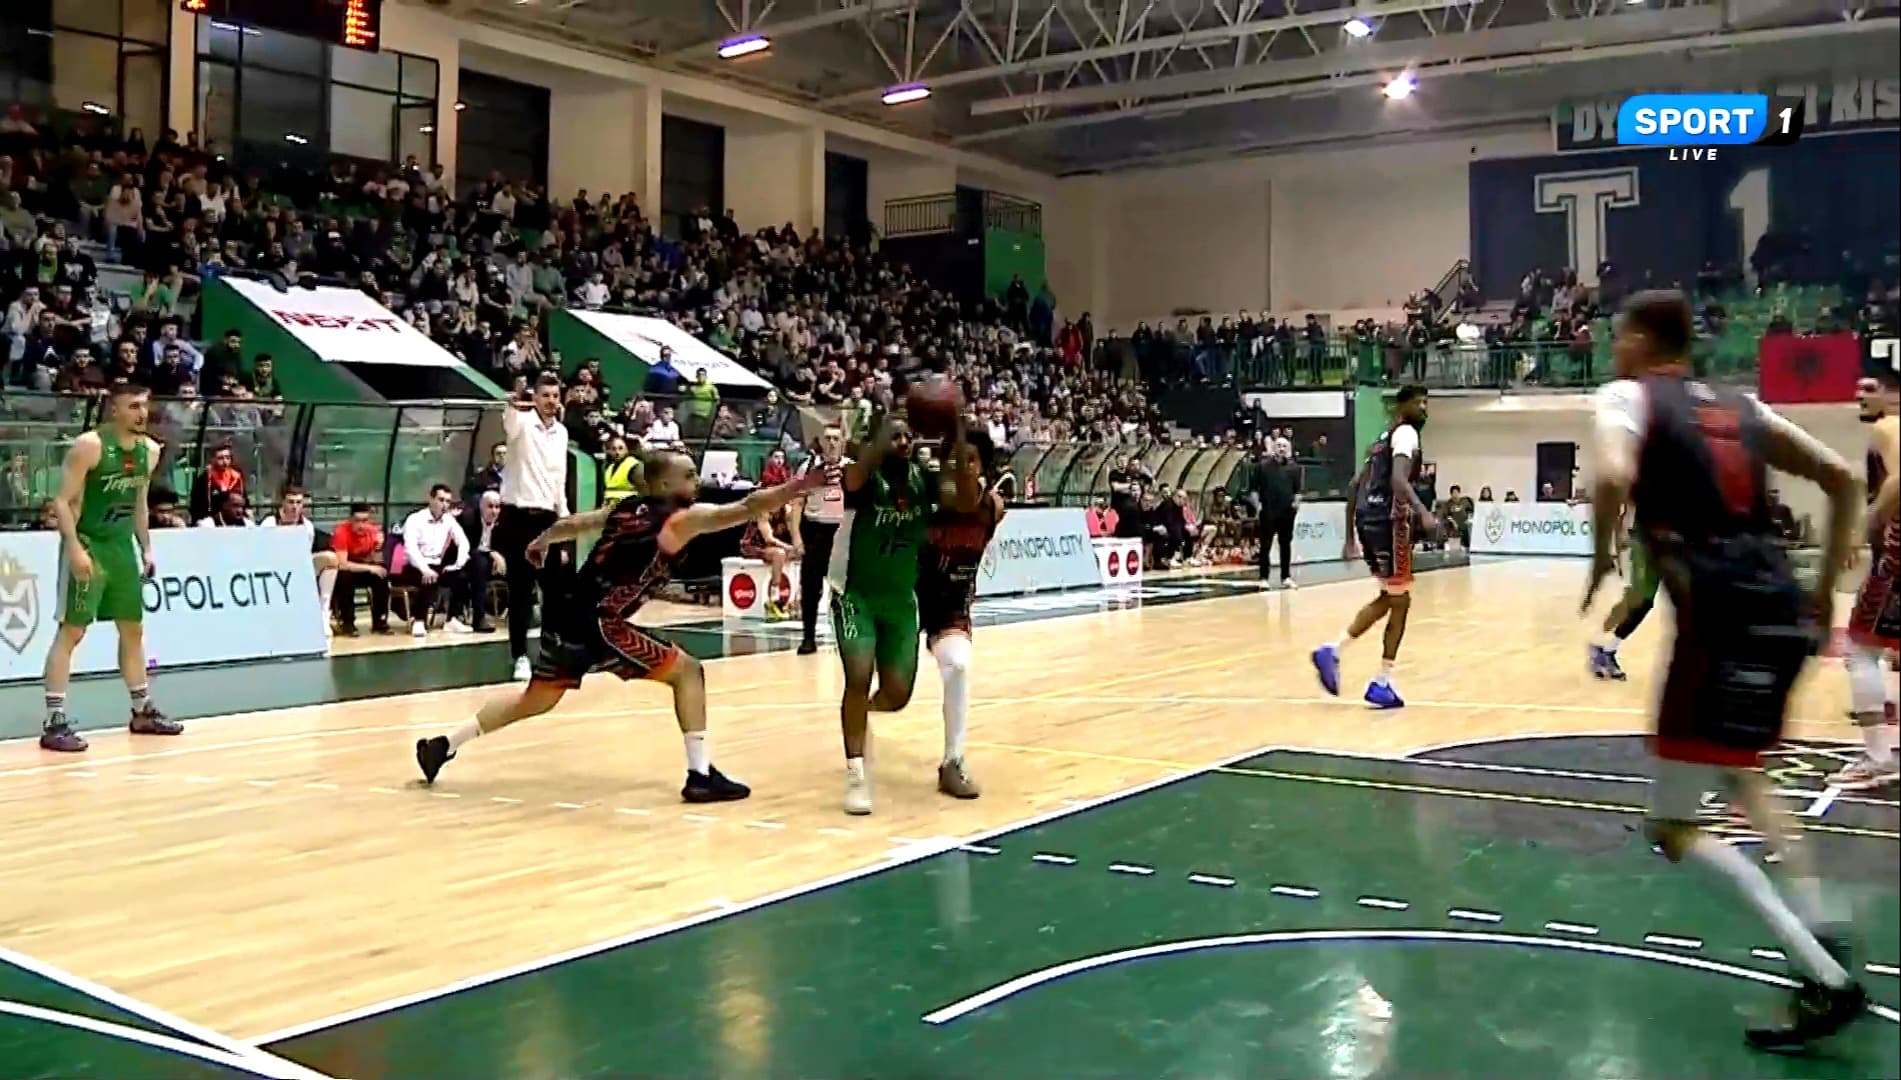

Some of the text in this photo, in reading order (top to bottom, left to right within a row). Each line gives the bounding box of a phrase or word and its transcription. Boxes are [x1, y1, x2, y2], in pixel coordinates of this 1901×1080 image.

[1510, 520, 1577, 536] MONOPOL
[1000, 536, 1060, 560] MONOPOL
[1060, 534, 1083, 557] CITY
[140, 571, 292, 613] OPOL CITY
